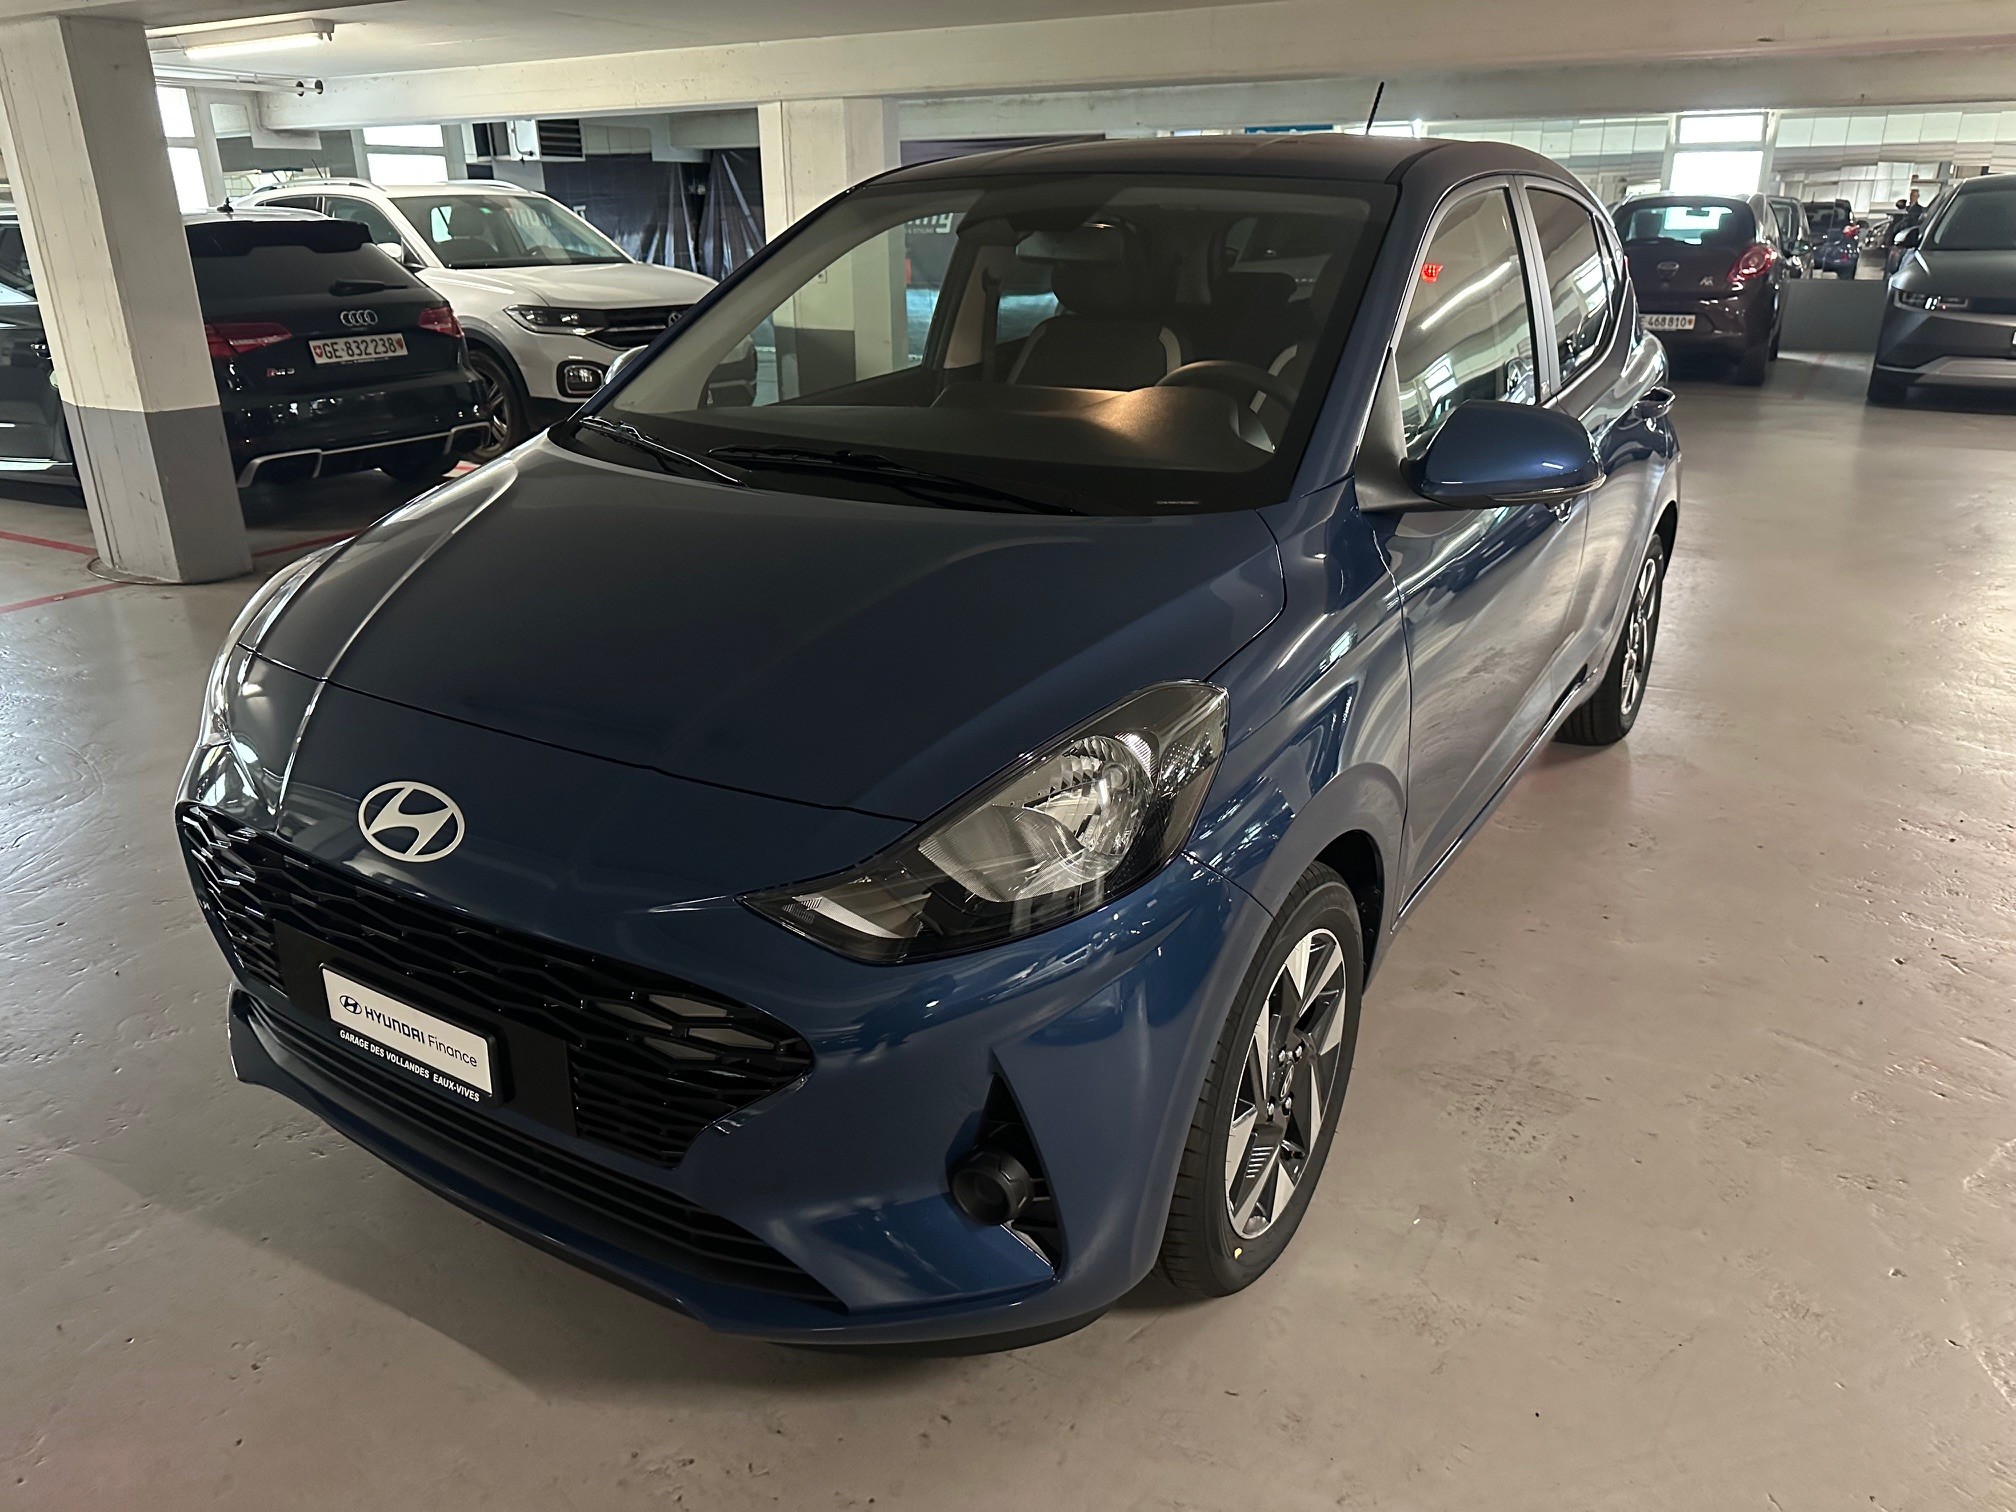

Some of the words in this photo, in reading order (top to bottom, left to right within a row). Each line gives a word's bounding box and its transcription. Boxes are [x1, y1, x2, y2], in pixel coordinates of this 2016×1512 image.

[339, 1029, 369, 1051] GARAGE
[370, 1039, 385, 1058] DES
[386, 1050, 430, 1079] VOLLANDES
[432, 1073, 480, 1102] EAUX-VIVES
[364, 1005, 425, 1044] HYUNDAI
[427, 1033, 478, 1068] Finance
